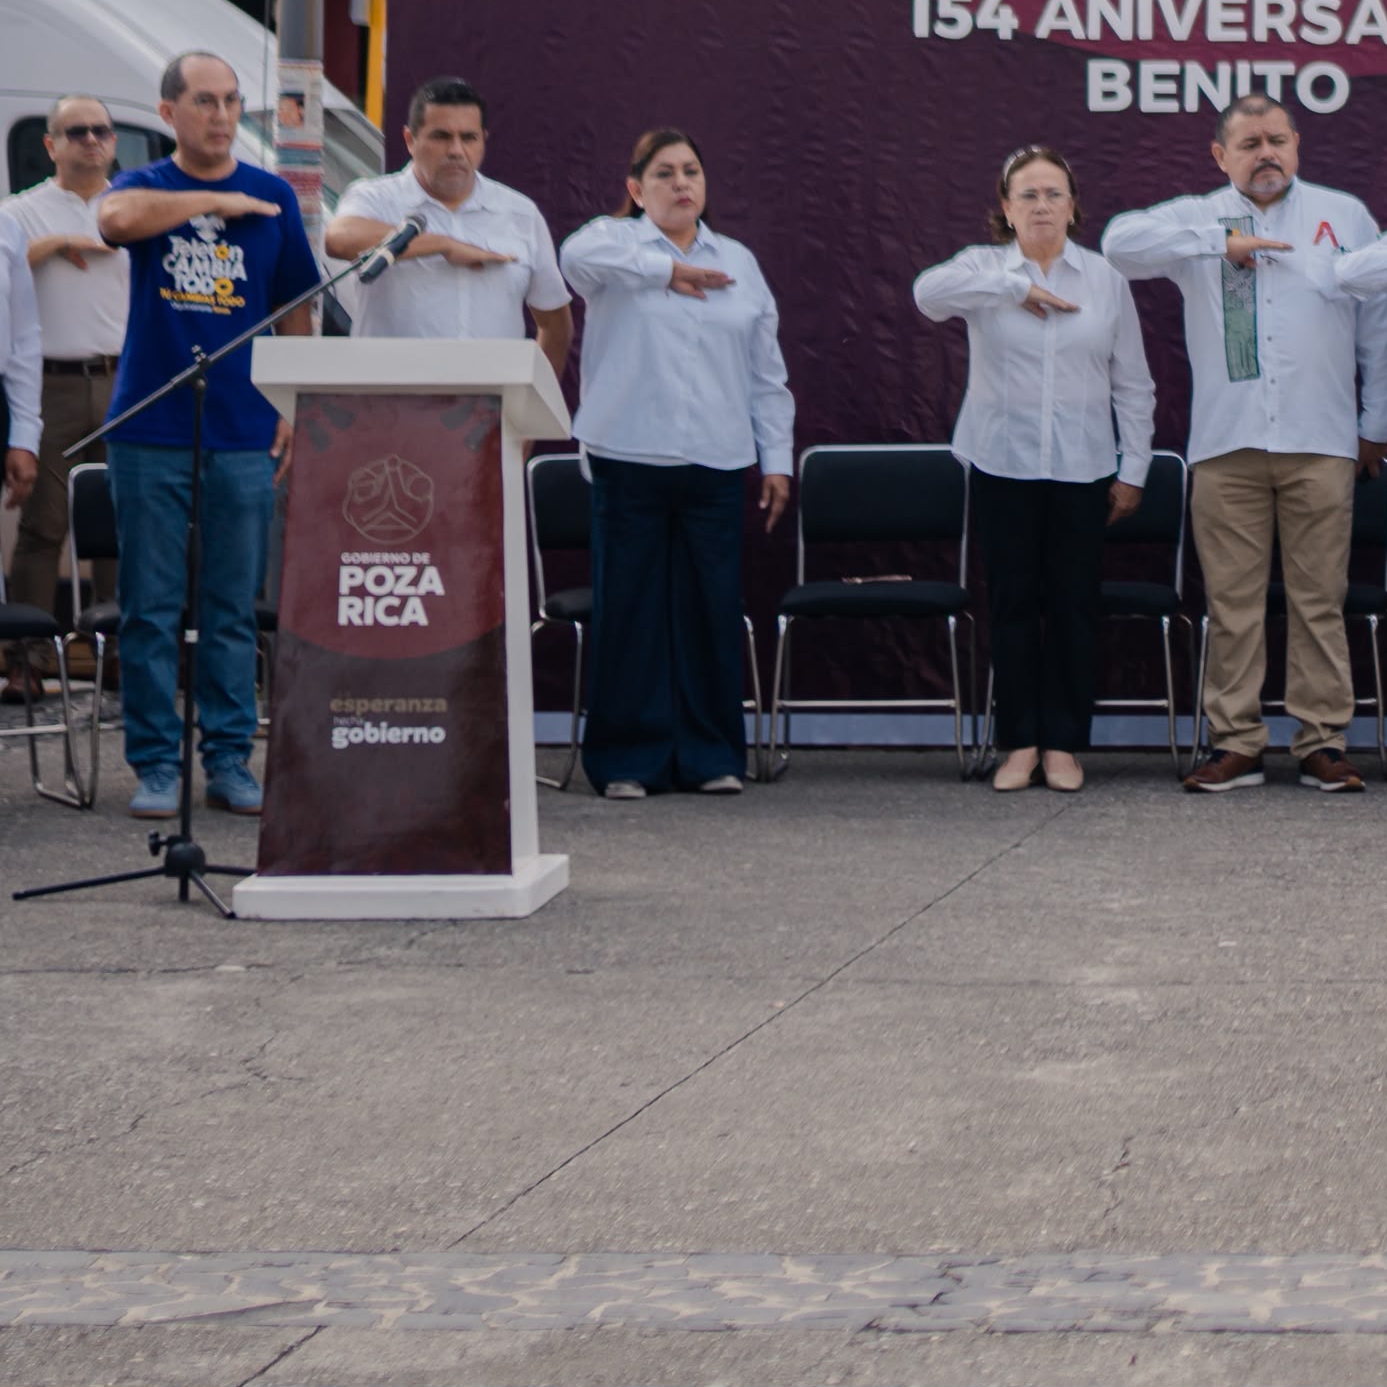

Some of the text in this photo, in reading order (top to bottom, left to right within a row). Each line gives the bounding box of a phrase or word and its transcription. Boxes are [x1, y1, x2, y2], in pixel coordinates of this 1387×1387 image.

[1086, 59, 1350, 114] BENITO
[162, 253, 248, 281] CAMBIA
[173, 273, 234, 297] TODO
[340, 552, 430, 564] GOBIERNO DE
[339, 565, 445, 596] POZA
[337, 596, 429, 626] RICA
[330, 697, 448, 716] esperanza
[331, 721, 446, 749] gobierno
